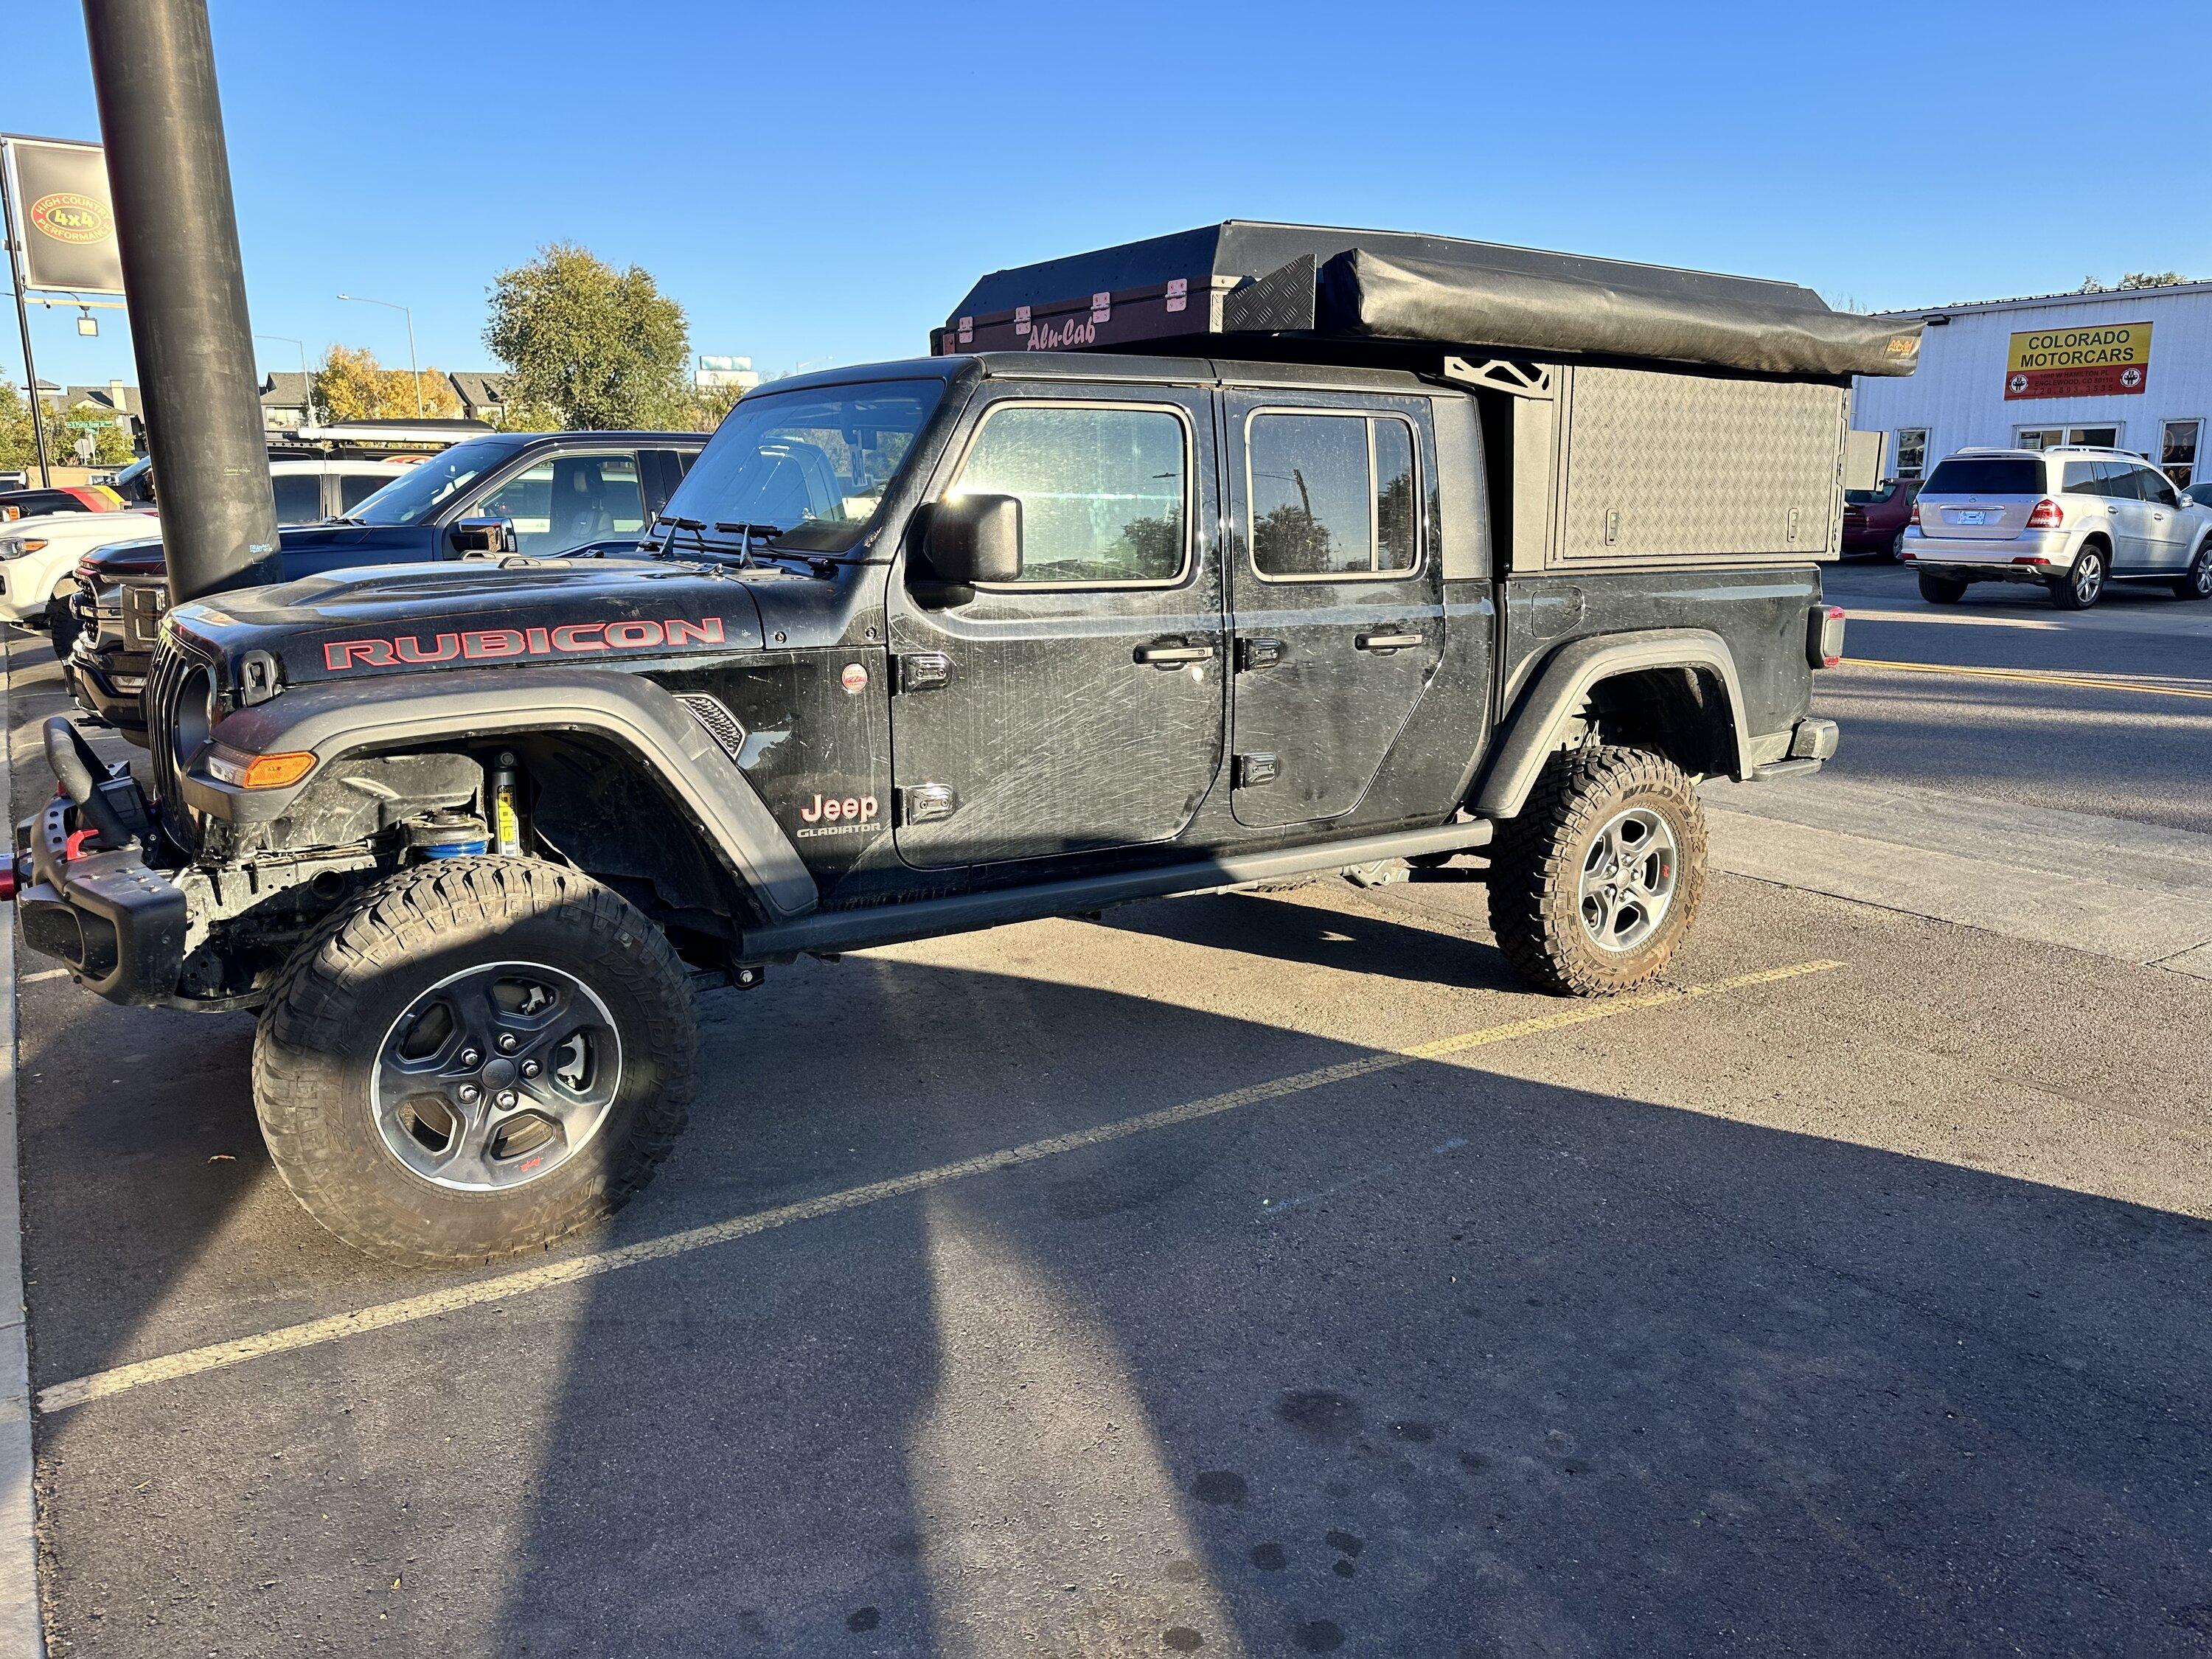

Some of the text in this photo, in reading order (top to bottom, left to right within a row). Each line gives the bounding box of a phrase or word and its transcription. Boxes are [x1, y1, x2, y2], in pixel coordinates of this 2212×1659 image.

[35, 196, 112, 220] HIGH COUNTRY
[55, 209, 94, 228] 4x4
[37, 218, 114, 241] PERFORMANCE
[1027, 316, 1096, 352] Alu-Cab
[2028, 330, 2130, 350] COLORADO
[2020, 347, 2135, 368] MOTORCARS
[323, 617, 725, 670] RUBICON
[801, 794, 878, 823] Jeep
[1621, 783, 1701, 853] WILDPEAK
[796, 823, 882, 838] GLADIATOR
